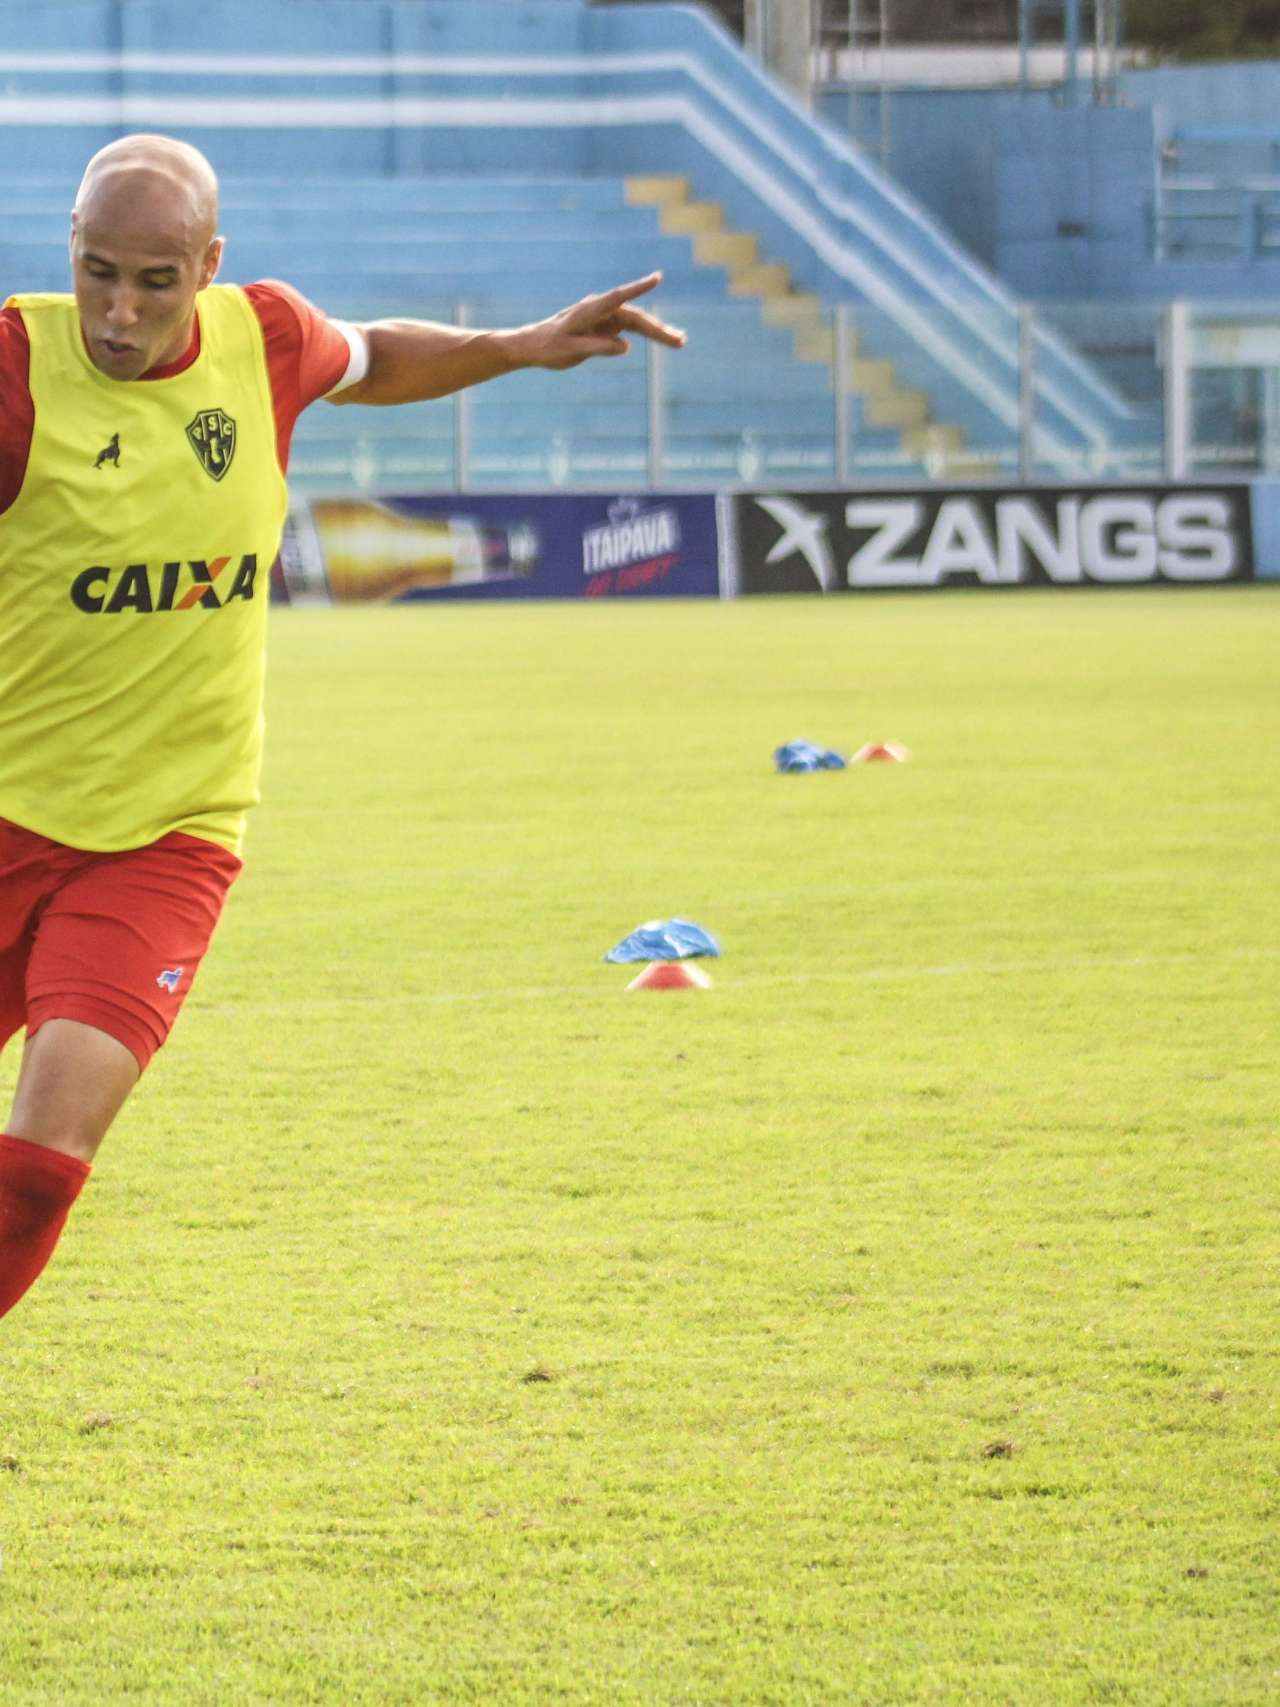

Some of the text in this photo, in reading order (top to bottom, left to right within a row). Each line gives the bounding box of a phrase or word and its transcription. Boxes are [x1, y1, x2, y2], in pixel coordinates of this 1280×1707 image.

[583, 509, 674, 574] ITAIPAVA
[844, 494, 1234, 587] ZANGS
[70, 553, 257, 614] CAIXA
